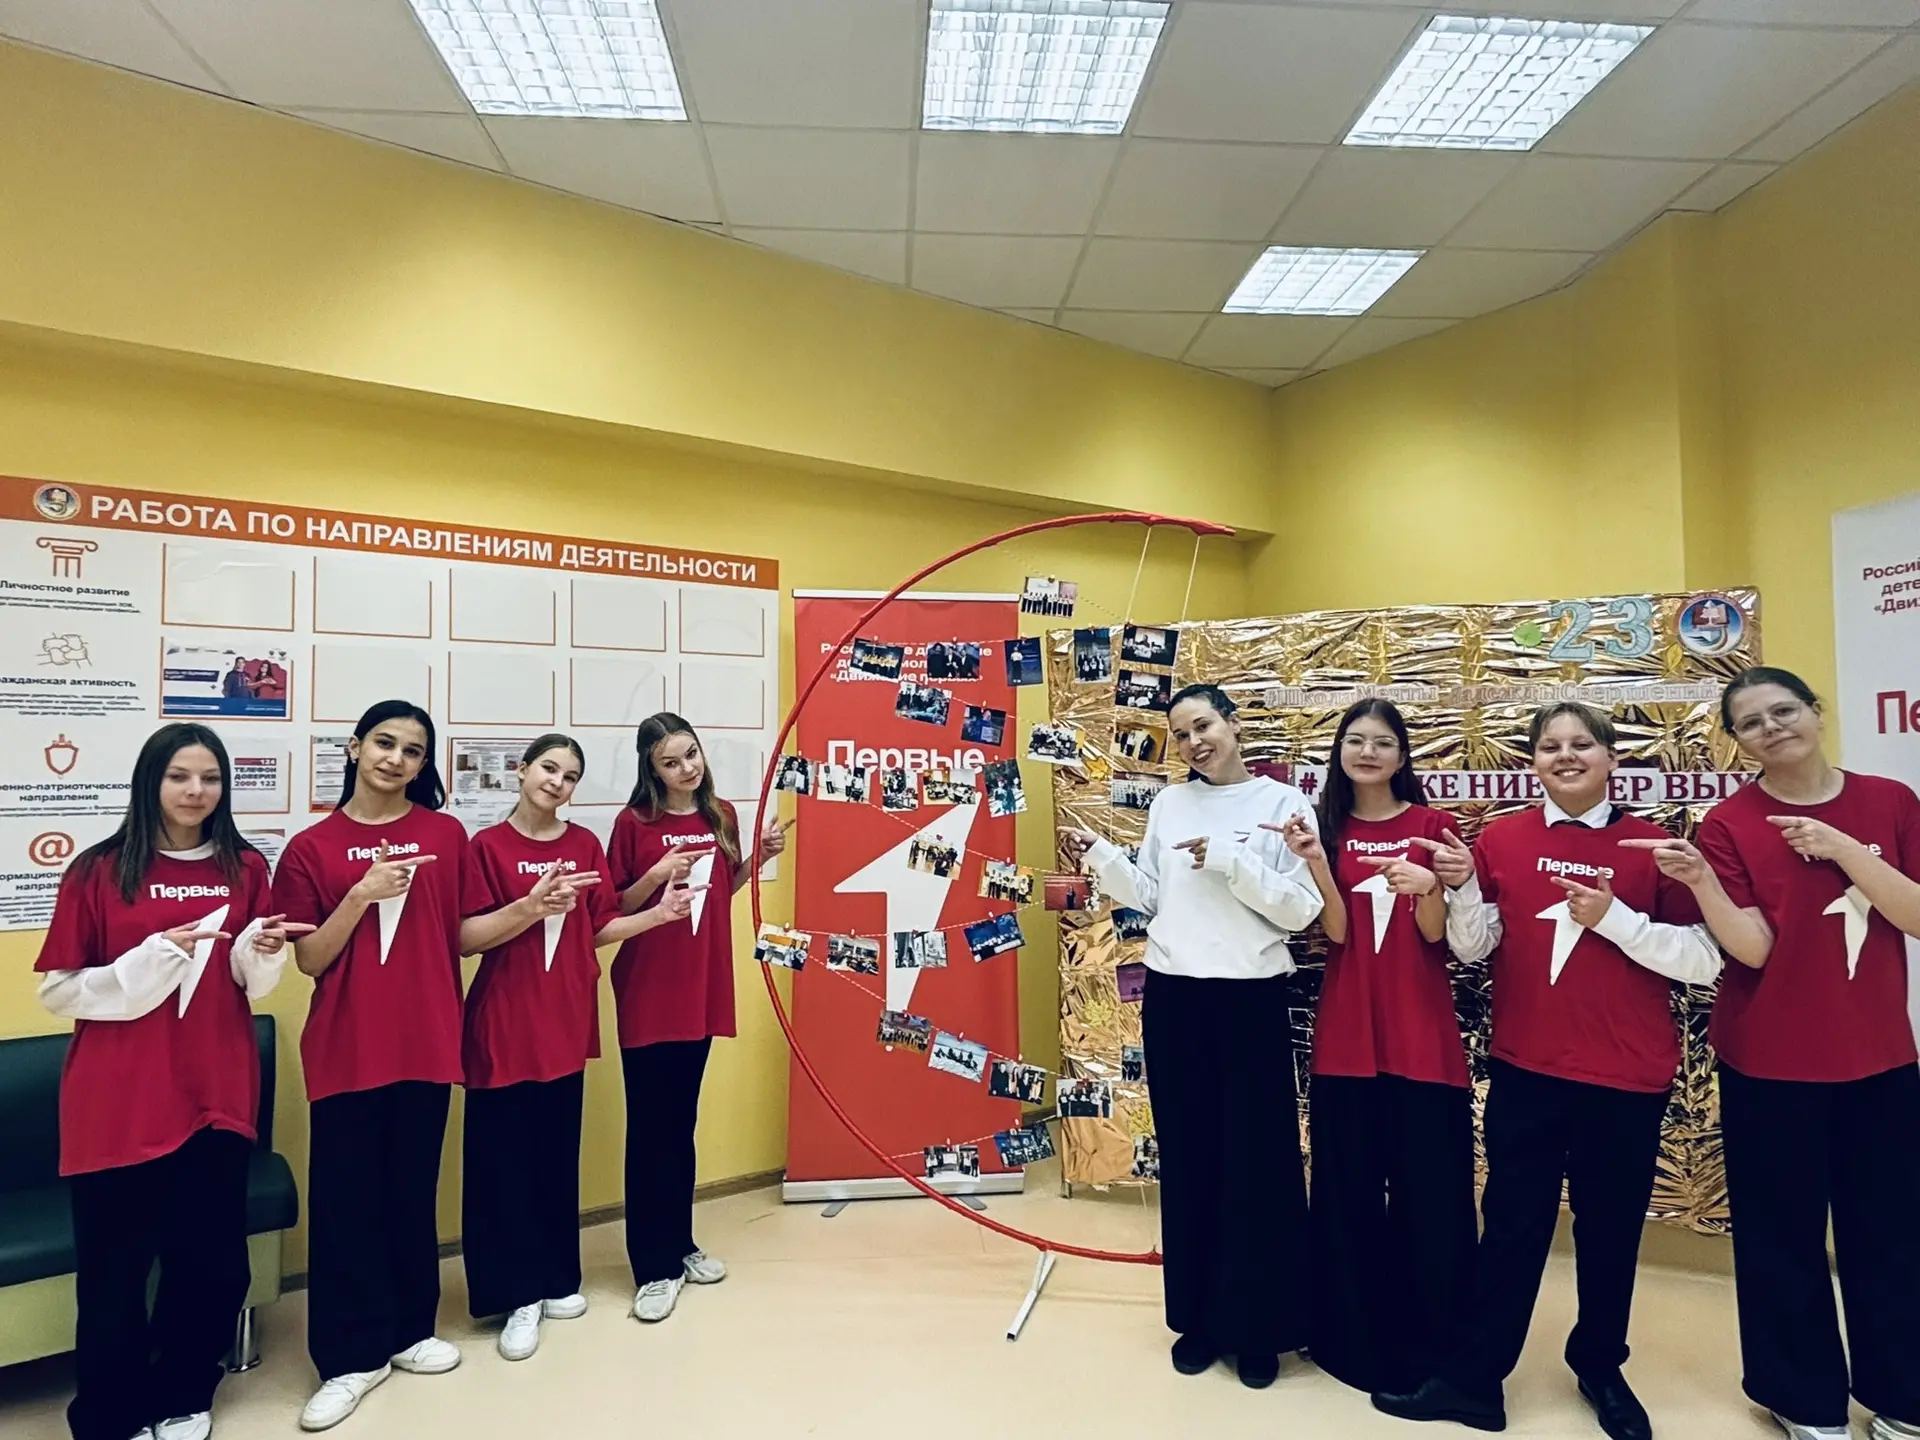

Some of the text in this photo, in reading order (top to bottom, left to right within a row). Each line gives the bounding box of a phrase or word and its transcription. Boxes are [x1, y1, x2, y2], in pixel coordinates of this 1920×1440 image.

[91, 495, 757, 583] РАБОТА ПО НАПРАВЛЕНИЯМ ДЕЯТЕЛЬНОСТИ
[0, 579, 130, 597] Личностное развитие
[1548, 597, 1654, 661] 23
[0, 676, 136, 688] ажданская активность
[19, 793, 99, 803] направление
[1346, 838, 1411, 854] Первые
[150, 883, 230, 901] Первые
